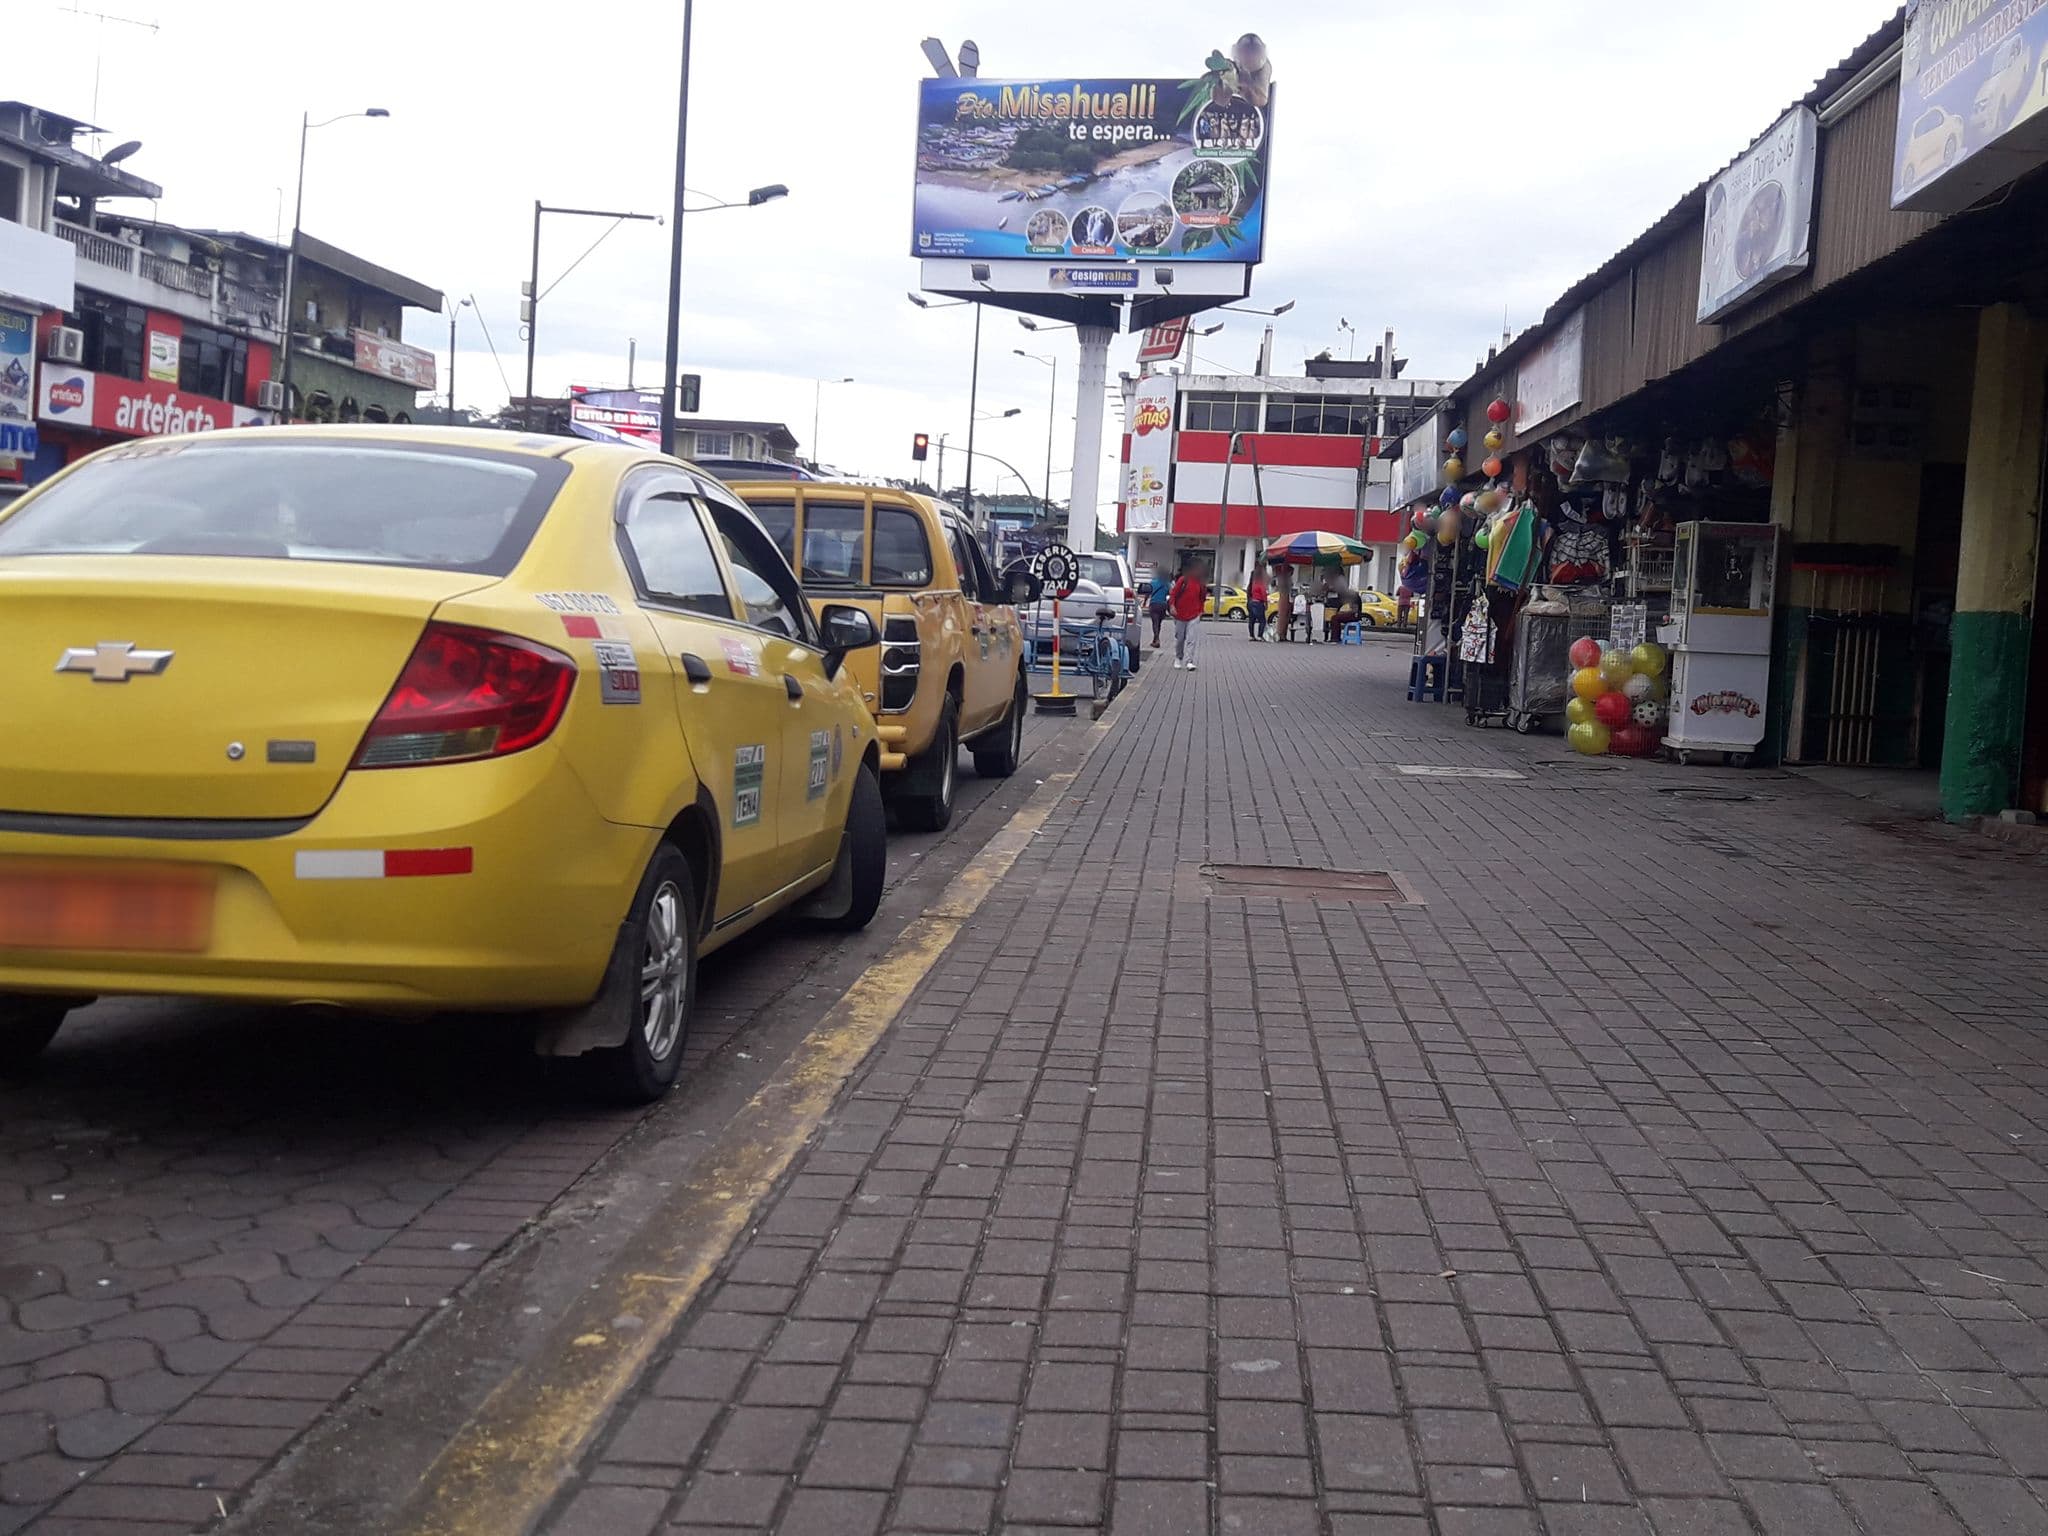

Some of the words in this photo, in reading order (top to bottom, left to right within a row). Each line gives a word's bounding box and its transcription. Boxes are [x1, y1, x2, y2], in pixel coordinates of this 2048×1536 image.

[1920, 33, 1976, 100] TERMINAL
[1977, 0, 2048, 55] TERREST
[999, 84, 1157, 119] Misahualli
[1069, 122, 1087, 140] te
[1092, 124, 1171, 145] espera...
[51, 389, 82, 404] artefacta
[116, 394, 214, 434] artefacta
[576, 409, 613, 423] ESTILO
[614, 411, 629, 424] EN
[630, 412, 656, 427] ROPA
[1034, 545, 1077, 580] RESERVADO
[1042, 580, 1068, 590] TAXI
